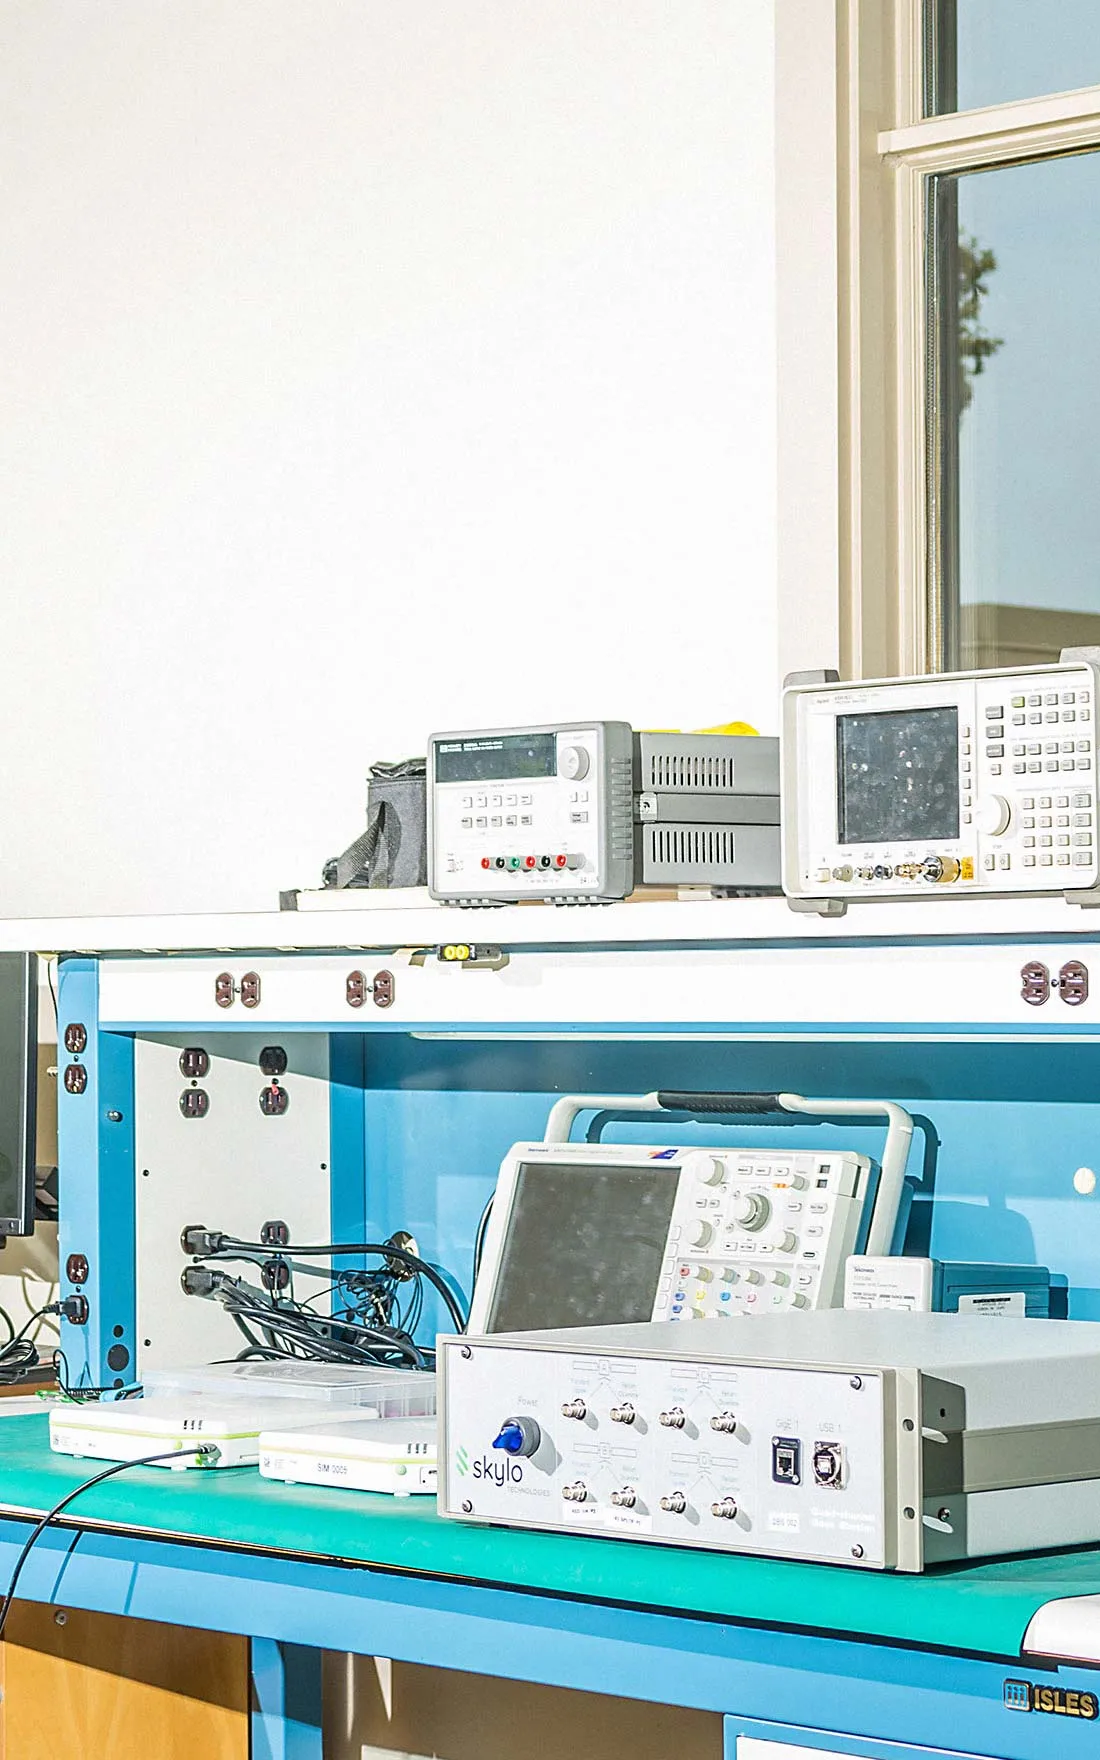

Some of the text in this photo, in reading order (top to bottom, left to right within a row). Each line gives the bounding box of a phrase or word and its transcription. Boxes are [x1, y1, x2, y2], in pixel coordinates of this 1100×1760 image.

[473, 1455, 523, 1487] skylo
[507, 1486, 550, 1497] TECHNOLOGIES
[1034, 1688, 1094, 1718] ISLES
